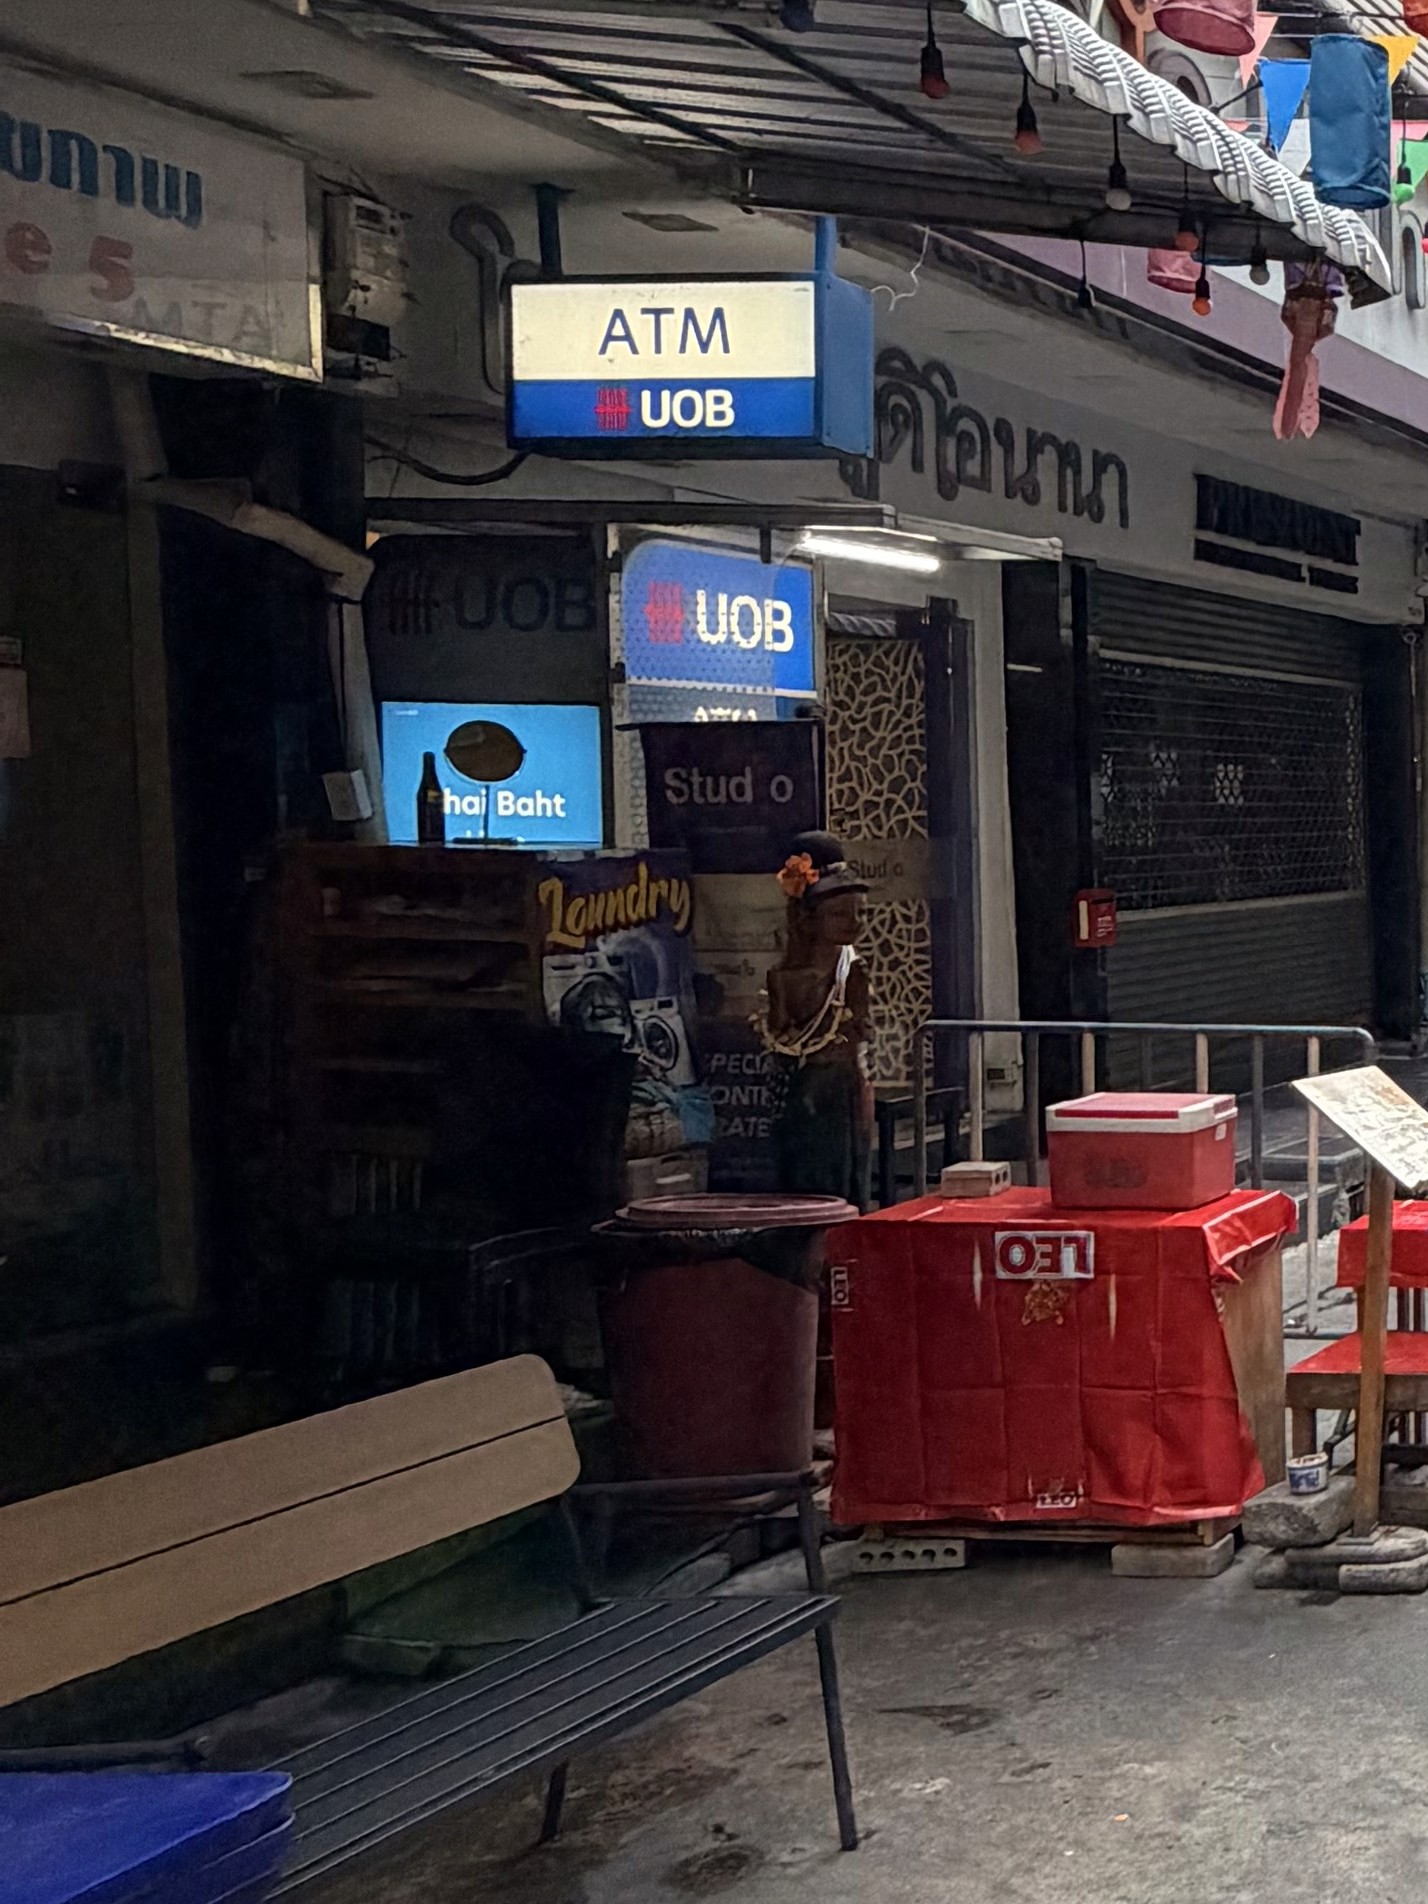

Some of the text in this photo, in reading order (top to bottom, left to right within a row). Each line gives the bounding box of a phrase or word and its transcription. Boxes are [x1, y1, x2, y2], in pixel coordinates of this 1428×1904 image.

[599, 307, 732, 356] ATM
[641, 390, 735, 429] UOB
[455, 574, 598, 631] UOB
[696, 589, 794, 652] UOB
[443, 787, 566, 817] hai Baht
[538, 860, 692, 952] Laundry
